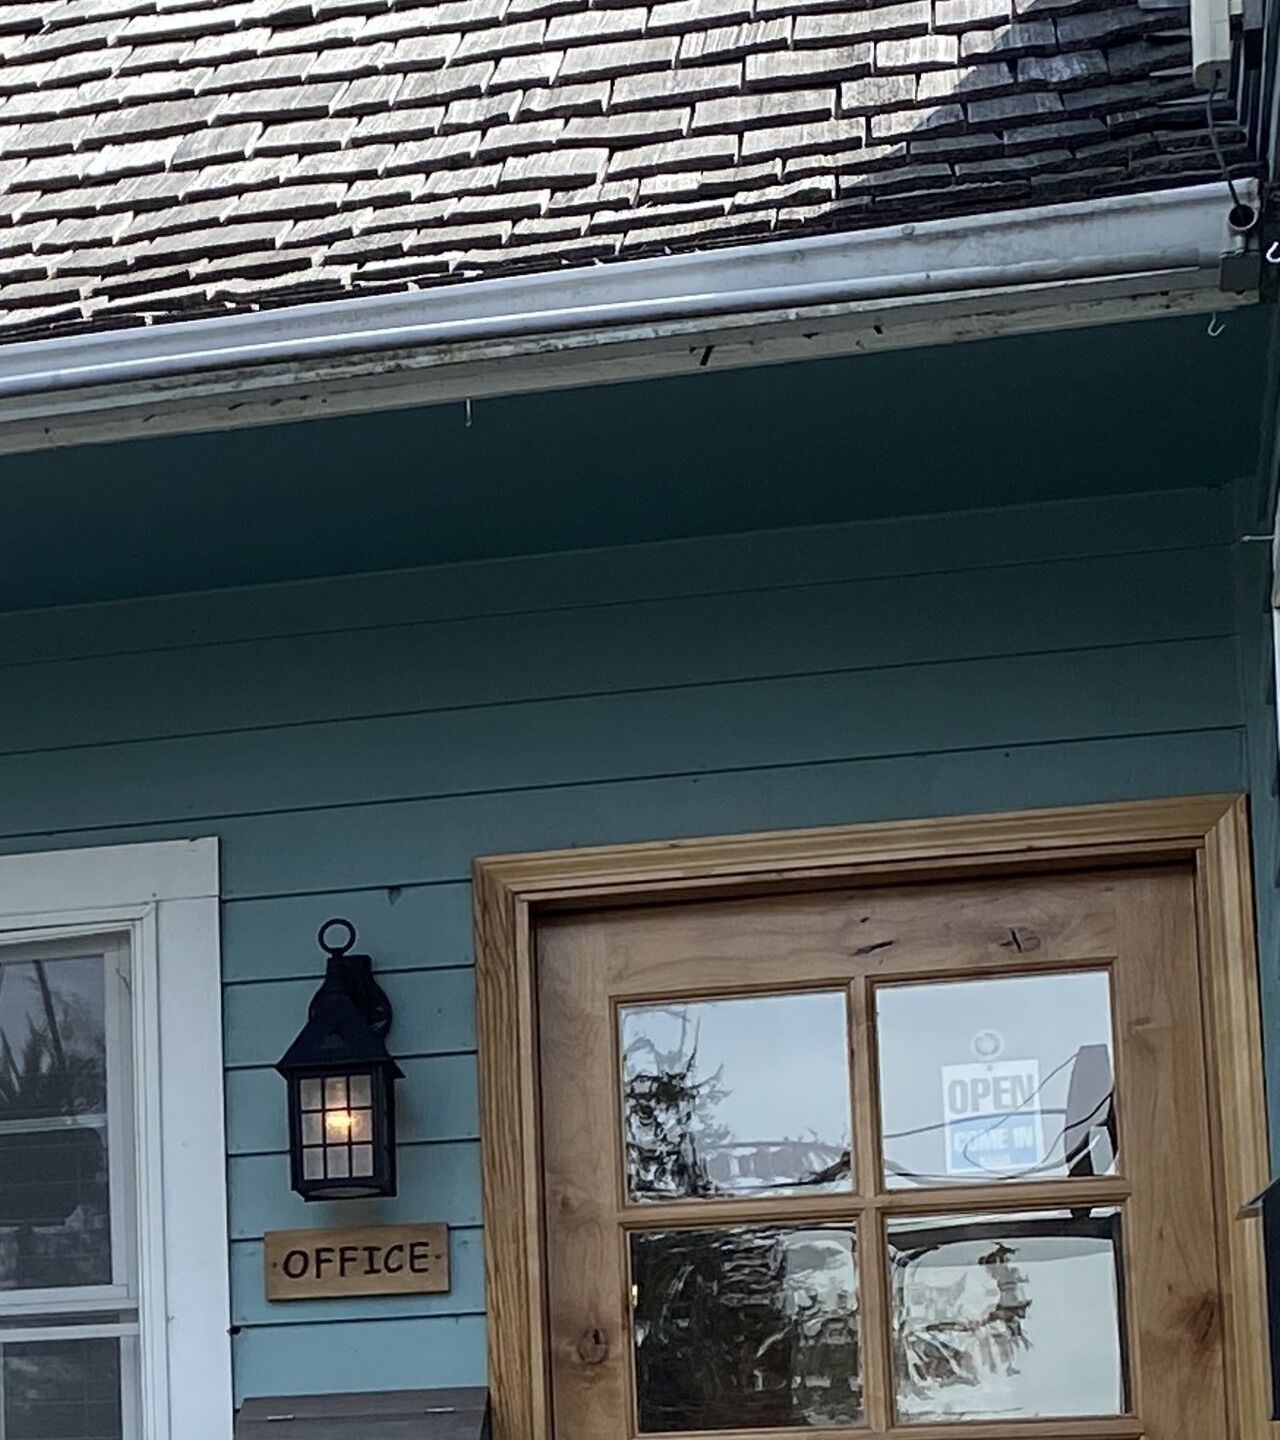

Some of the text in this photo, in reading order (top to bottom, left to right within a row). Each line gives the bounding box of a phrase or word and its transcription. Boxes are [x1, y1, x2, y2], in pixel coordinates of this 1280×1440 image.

[947, 1073, 1035, 1116] OPEN
[1012, 1126, 1034, 1148] IN
[282, 1241, 430, 1280] OFFICE
